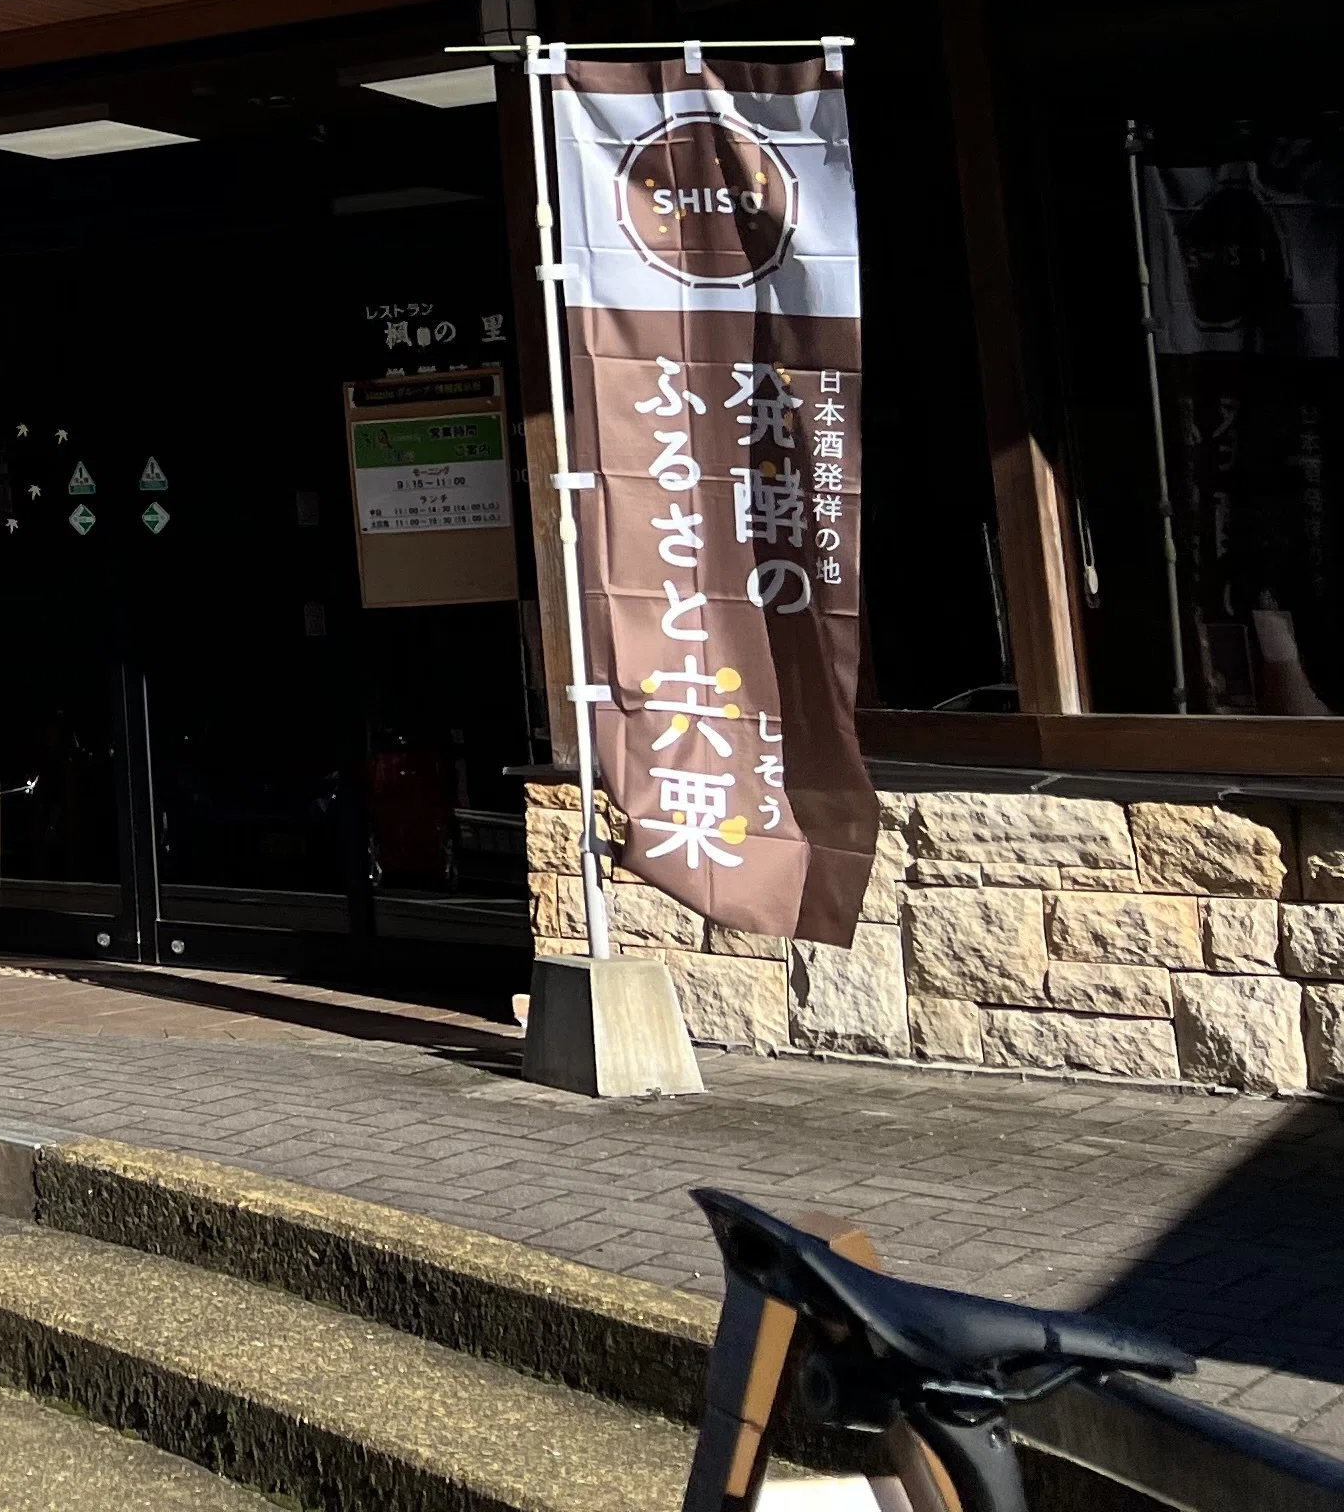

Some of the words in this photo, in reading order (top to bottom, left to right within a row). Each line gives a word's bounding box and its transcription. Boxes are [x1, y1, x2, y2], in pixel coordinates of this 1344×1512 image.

[652, 187, 764, 215] SHISO
[366, 303, 433, 320] レストラン
[812, 369, 846, 585] 日本酒発祥の地
[420, 494, 447, 504] ランチ
[754, 710, 786, 830] しそう
